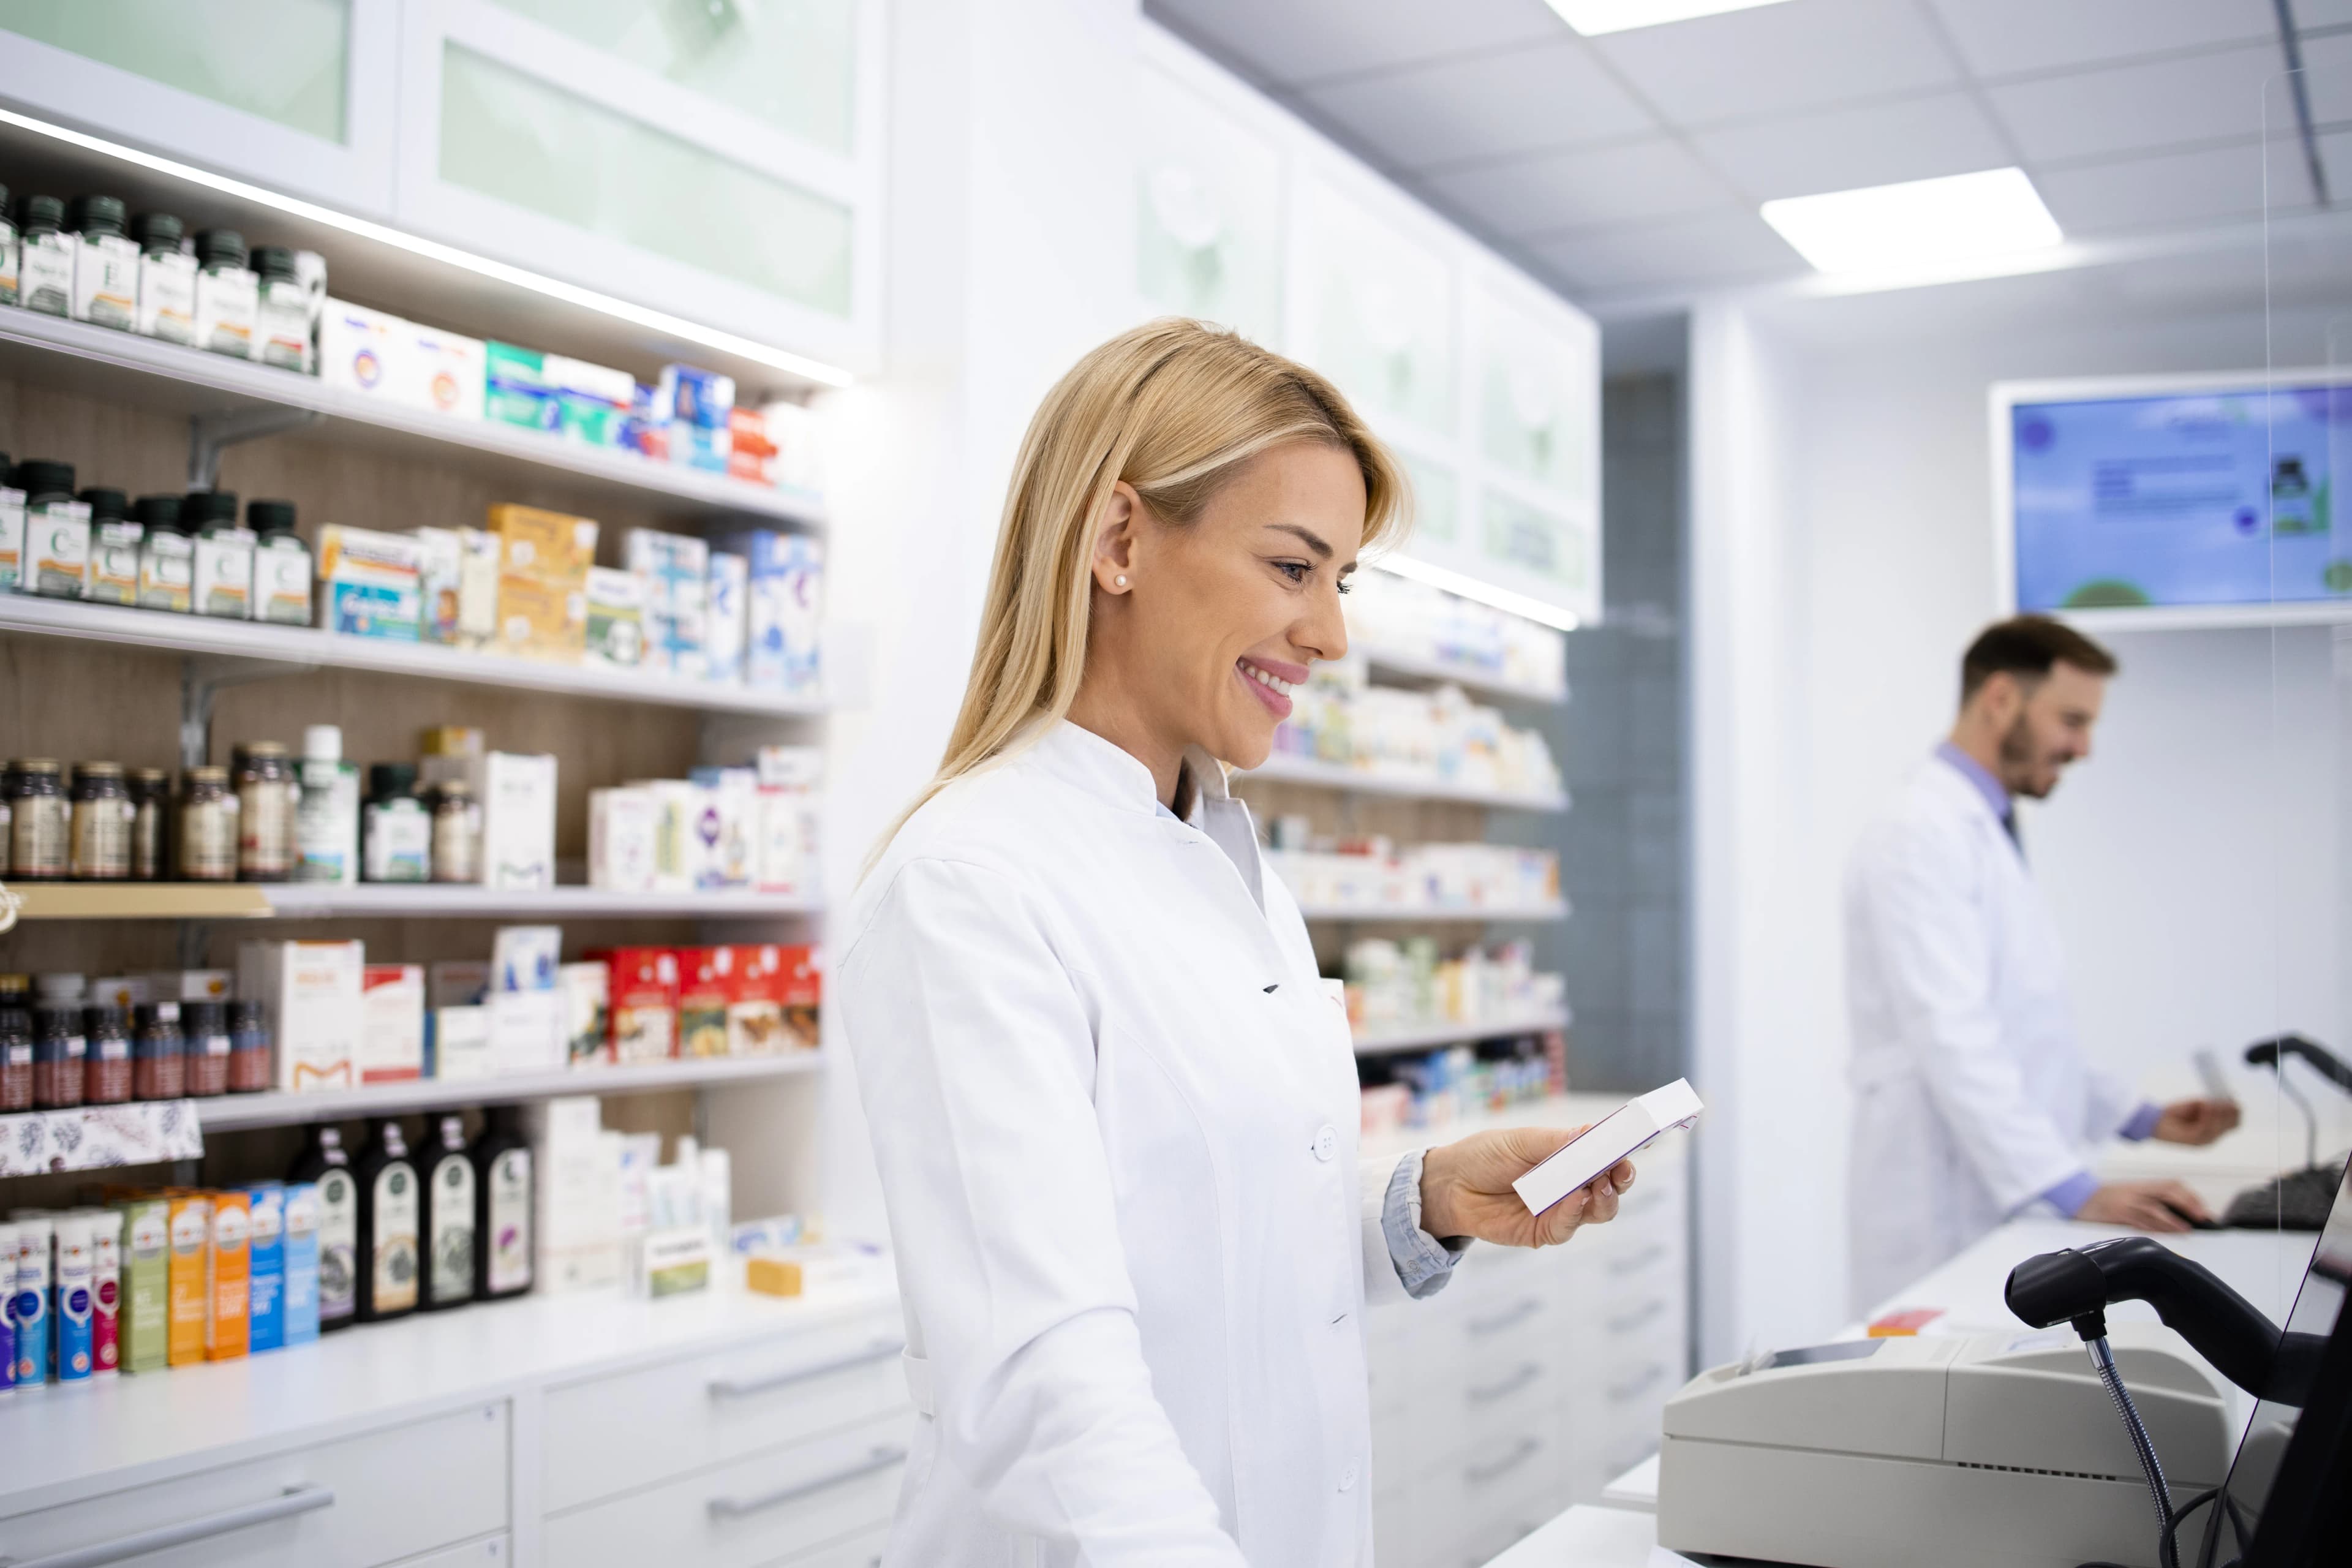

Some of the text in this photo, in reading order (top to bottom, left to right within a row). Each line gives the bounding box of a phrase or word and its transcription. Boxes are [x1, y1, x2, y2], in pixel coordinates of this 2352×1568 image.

[104, 262, 119, 290] E
[50, 529, 69, 559] C
[105, 547, 123, 576] C
[215, 552, 235, 583] C
